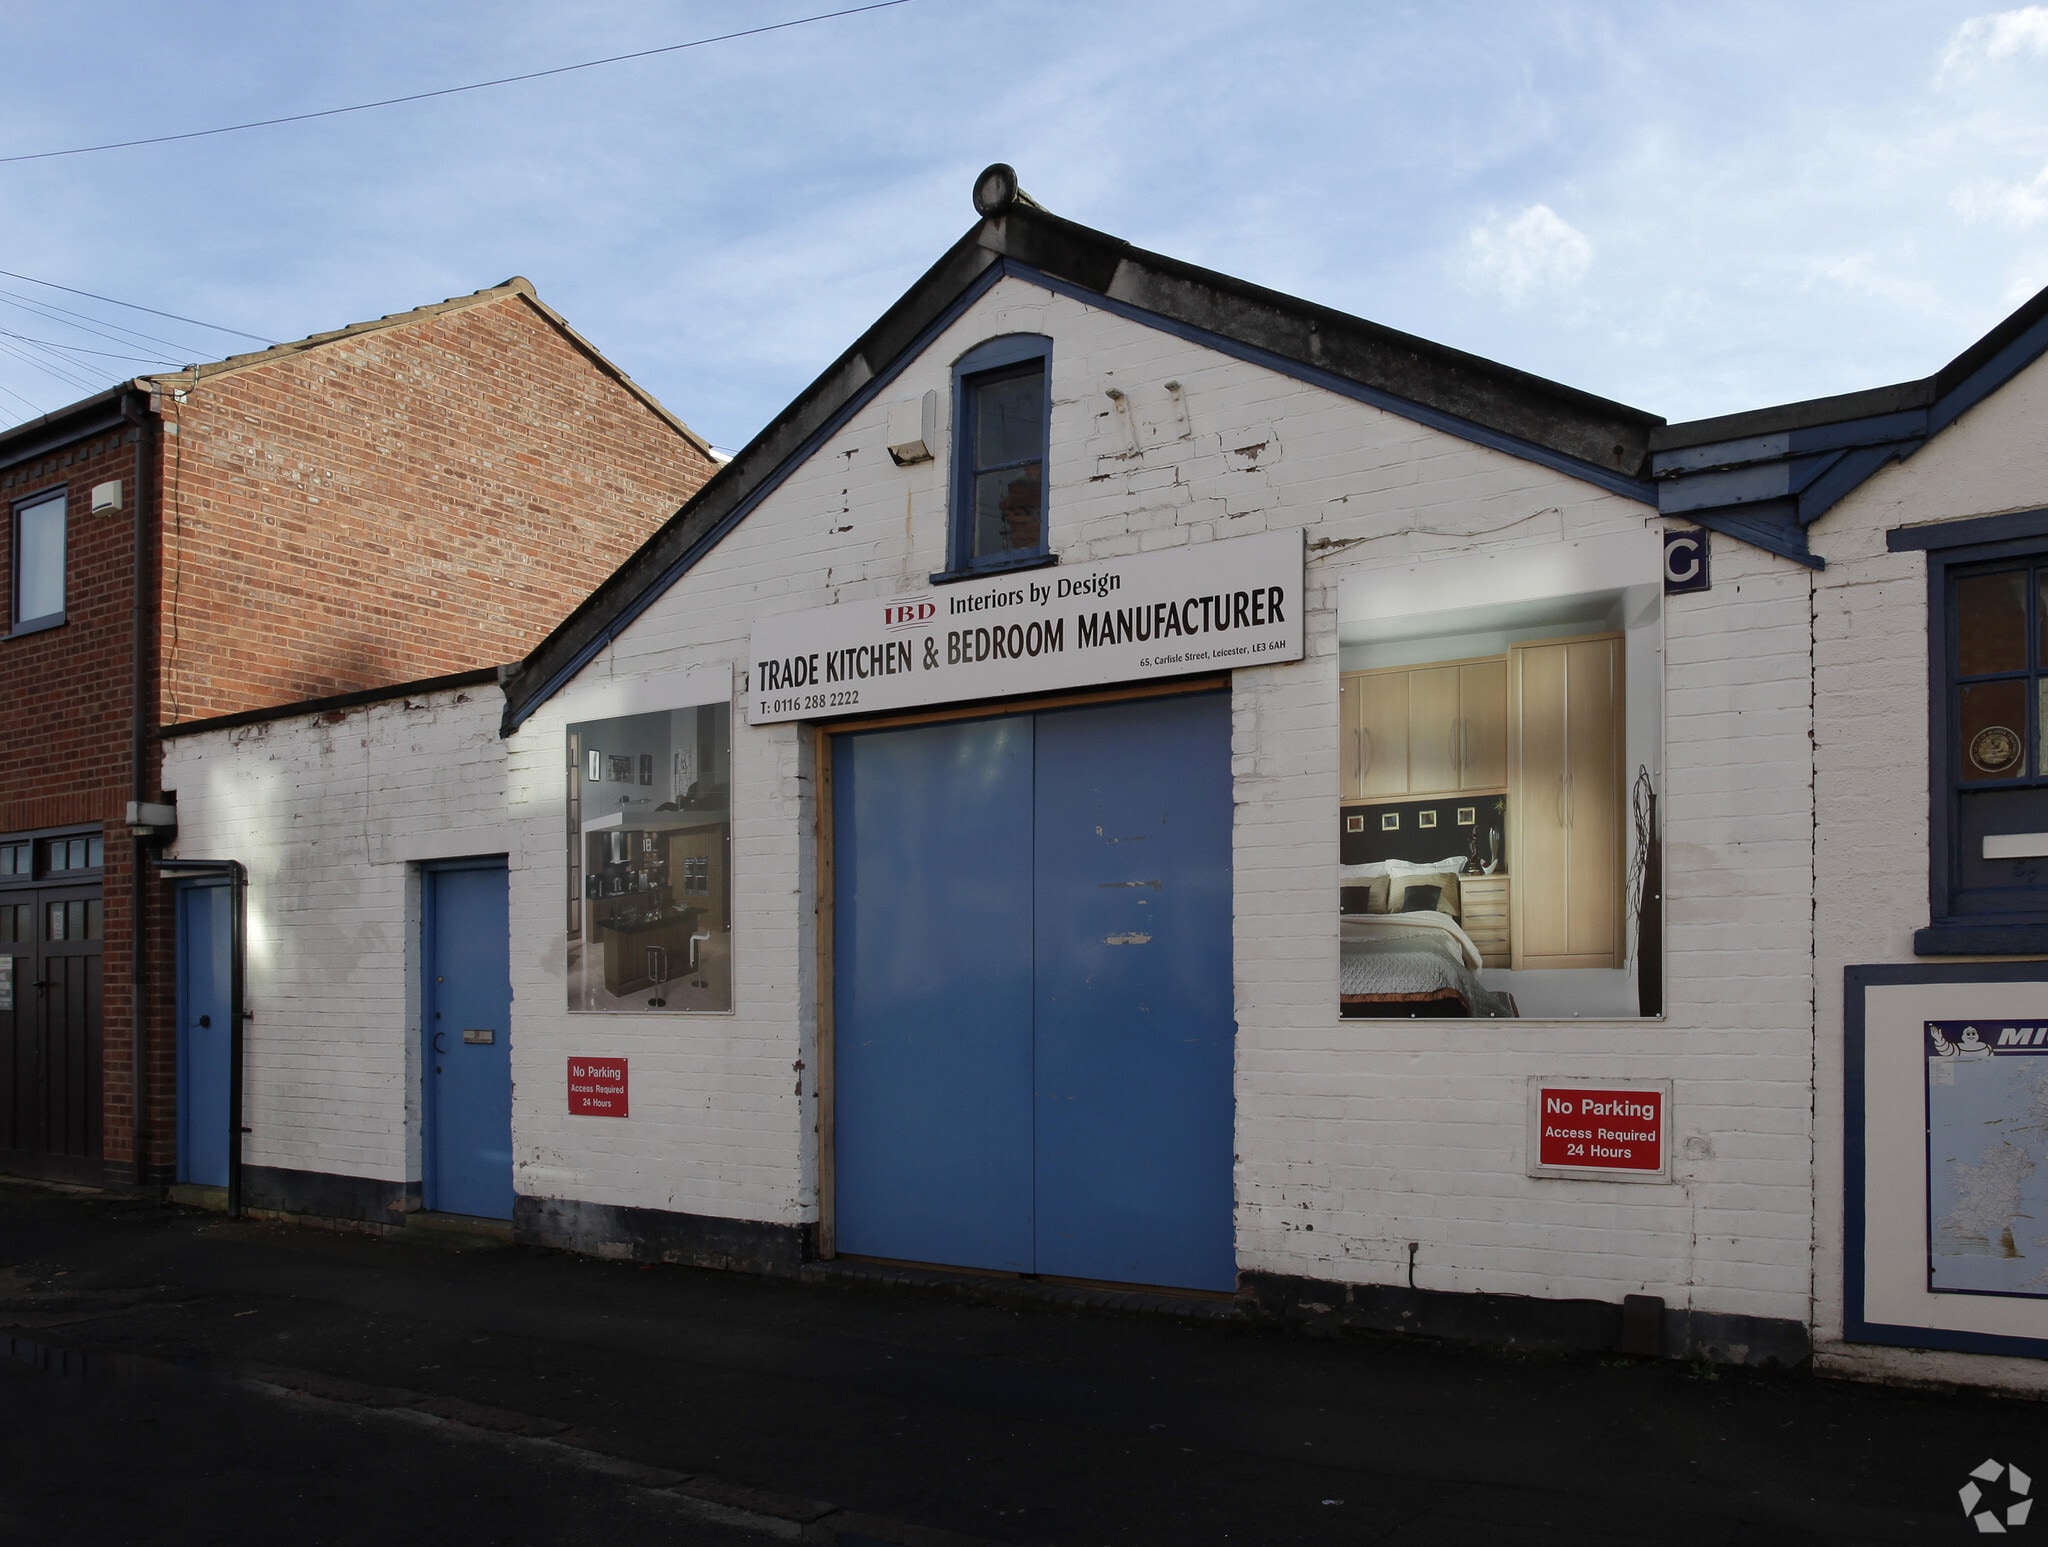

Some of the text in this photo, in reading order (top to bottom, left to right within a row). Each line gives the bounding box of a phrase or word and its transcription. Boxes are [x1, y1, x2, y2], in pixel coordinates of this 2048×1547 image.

[950, 573, 1121, 615] Interiors by Design
[884, 603, 936, 625] IBD
[758, 586, 1285, 692] TRADE KITCHEN & BEDROOM MANUFACTURER
[1140, 640, 1286, 667] 65, Carlisle Street, Leicester, LE3 6AH
[760, 690, 859, 715] T: 0116 288 2222
[1997, 1028, 2048, 1046] MI
[572, 1065, 621, 1080] No Parking
[571, 1084, 624, 1095] Access Required
[582, 1098, 612, 1108] 24 Hours
[1547, 1097, 1655, 1121] No Parking
[1545, 1126, 1656, 1142] Access Required
[1567, 1143, 1632, 1159] 24 Hours
